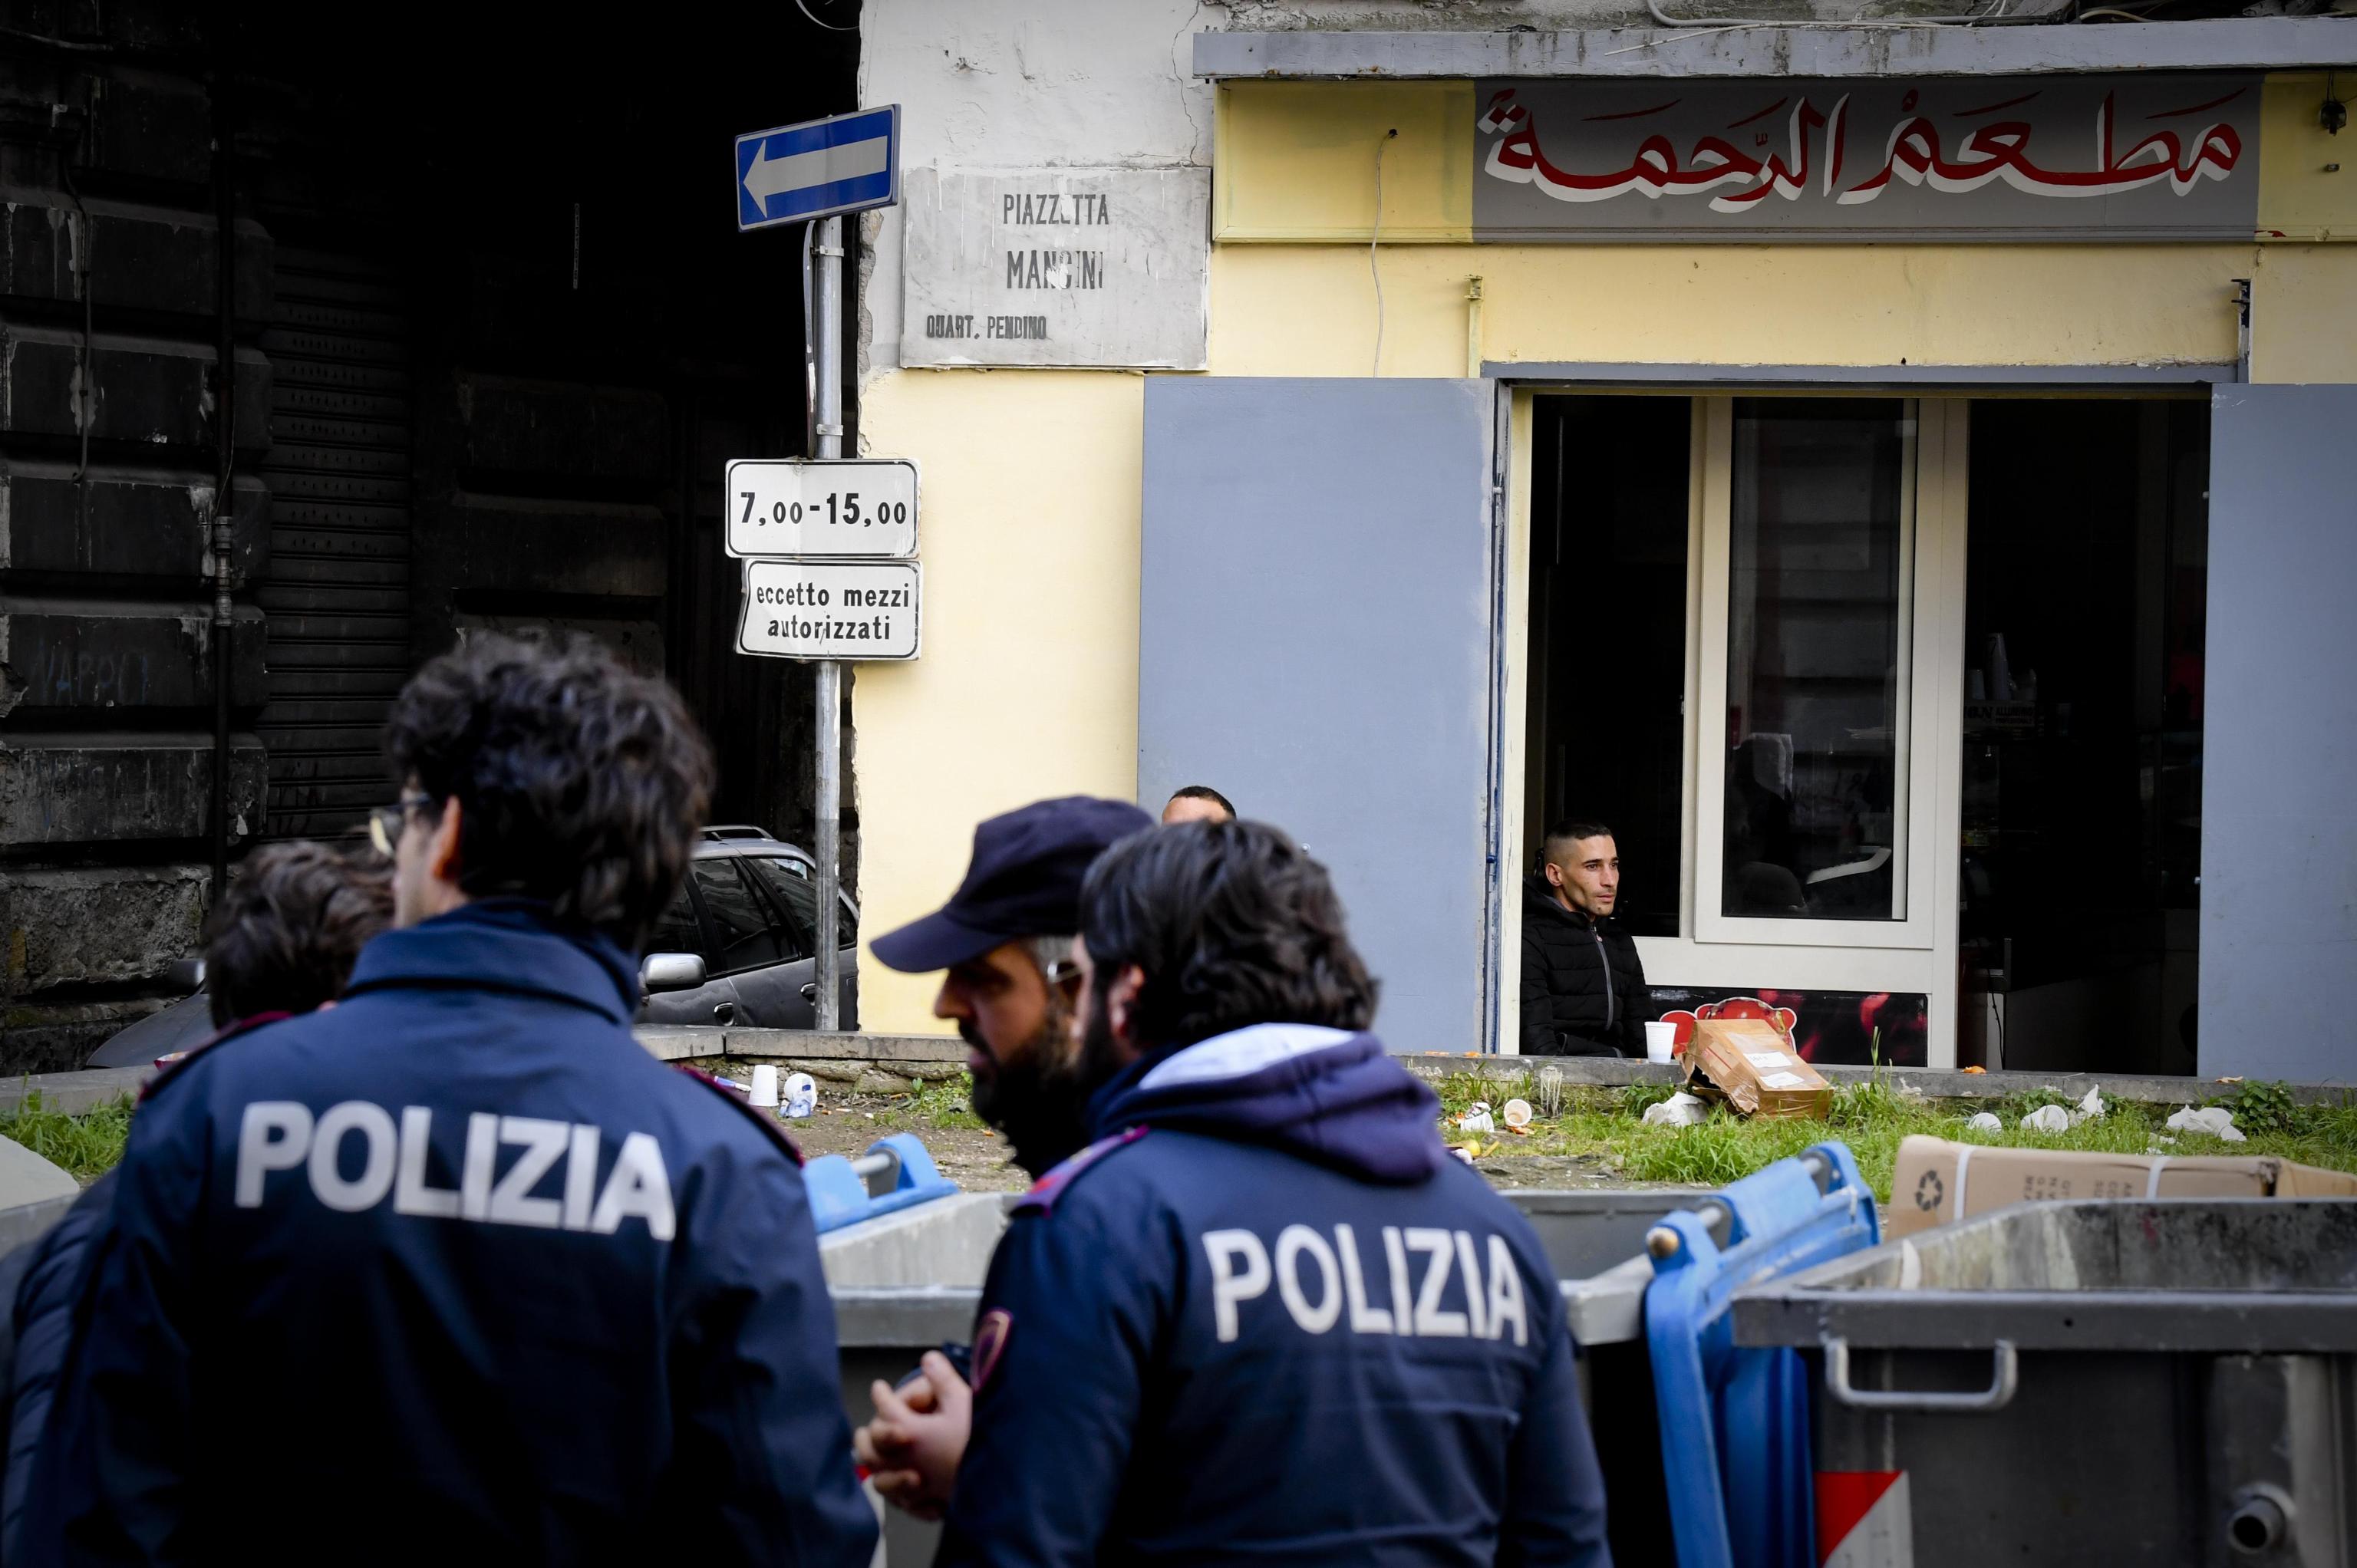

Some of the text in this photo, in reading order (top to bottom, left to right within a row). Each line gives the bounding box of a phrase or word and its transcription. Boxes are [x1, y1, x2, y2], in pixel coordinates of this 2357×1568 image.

[926, 315, 1047, 340] QUART. PENDINO
[757, 582, 909, 608] eccetto mezzi
[767, 615, 890, 641] autorizzati
[236, 1100, 676, 1241] POLIZIA
[1202, 1223, 1528, 1346] POLIZIA
